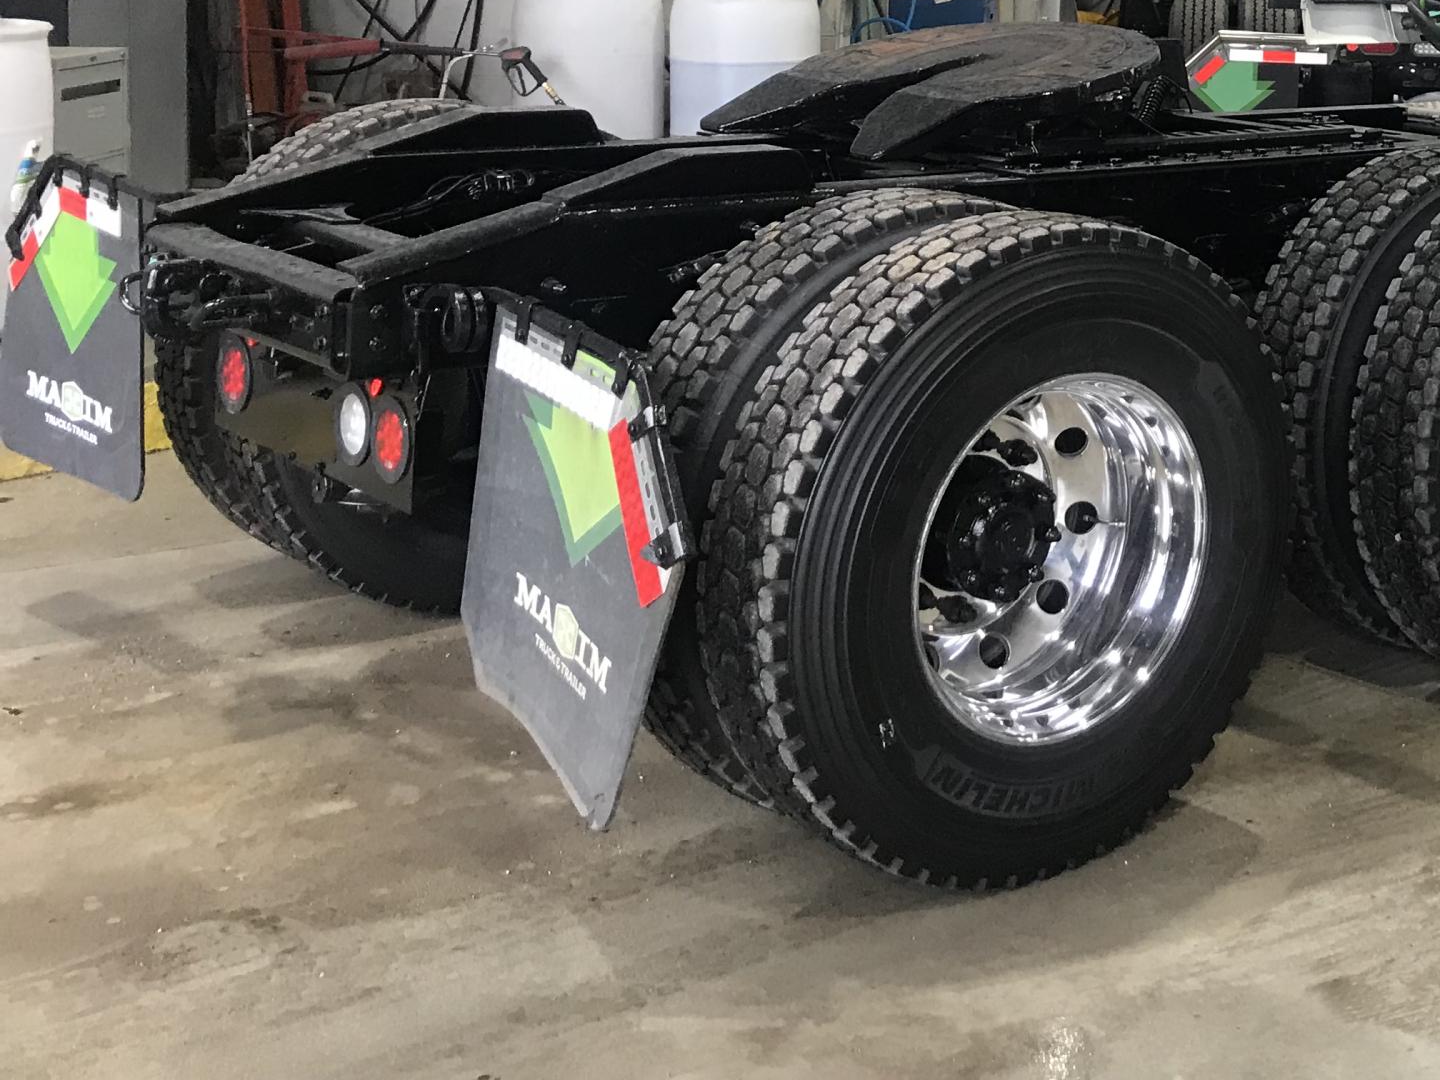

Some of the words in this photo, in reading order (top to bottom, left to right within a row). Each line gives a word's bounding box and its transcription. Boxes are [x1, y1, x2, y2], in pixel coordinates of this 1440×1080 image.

[25, 369, 113, 434] MAXIM
[513, 571, 612, 695] MAXIM
[534, 632, 556, 666] TRUCK
[560, 661, 587, 700] TRAILER
[930, 765, 1096, 815] MICHELIN
